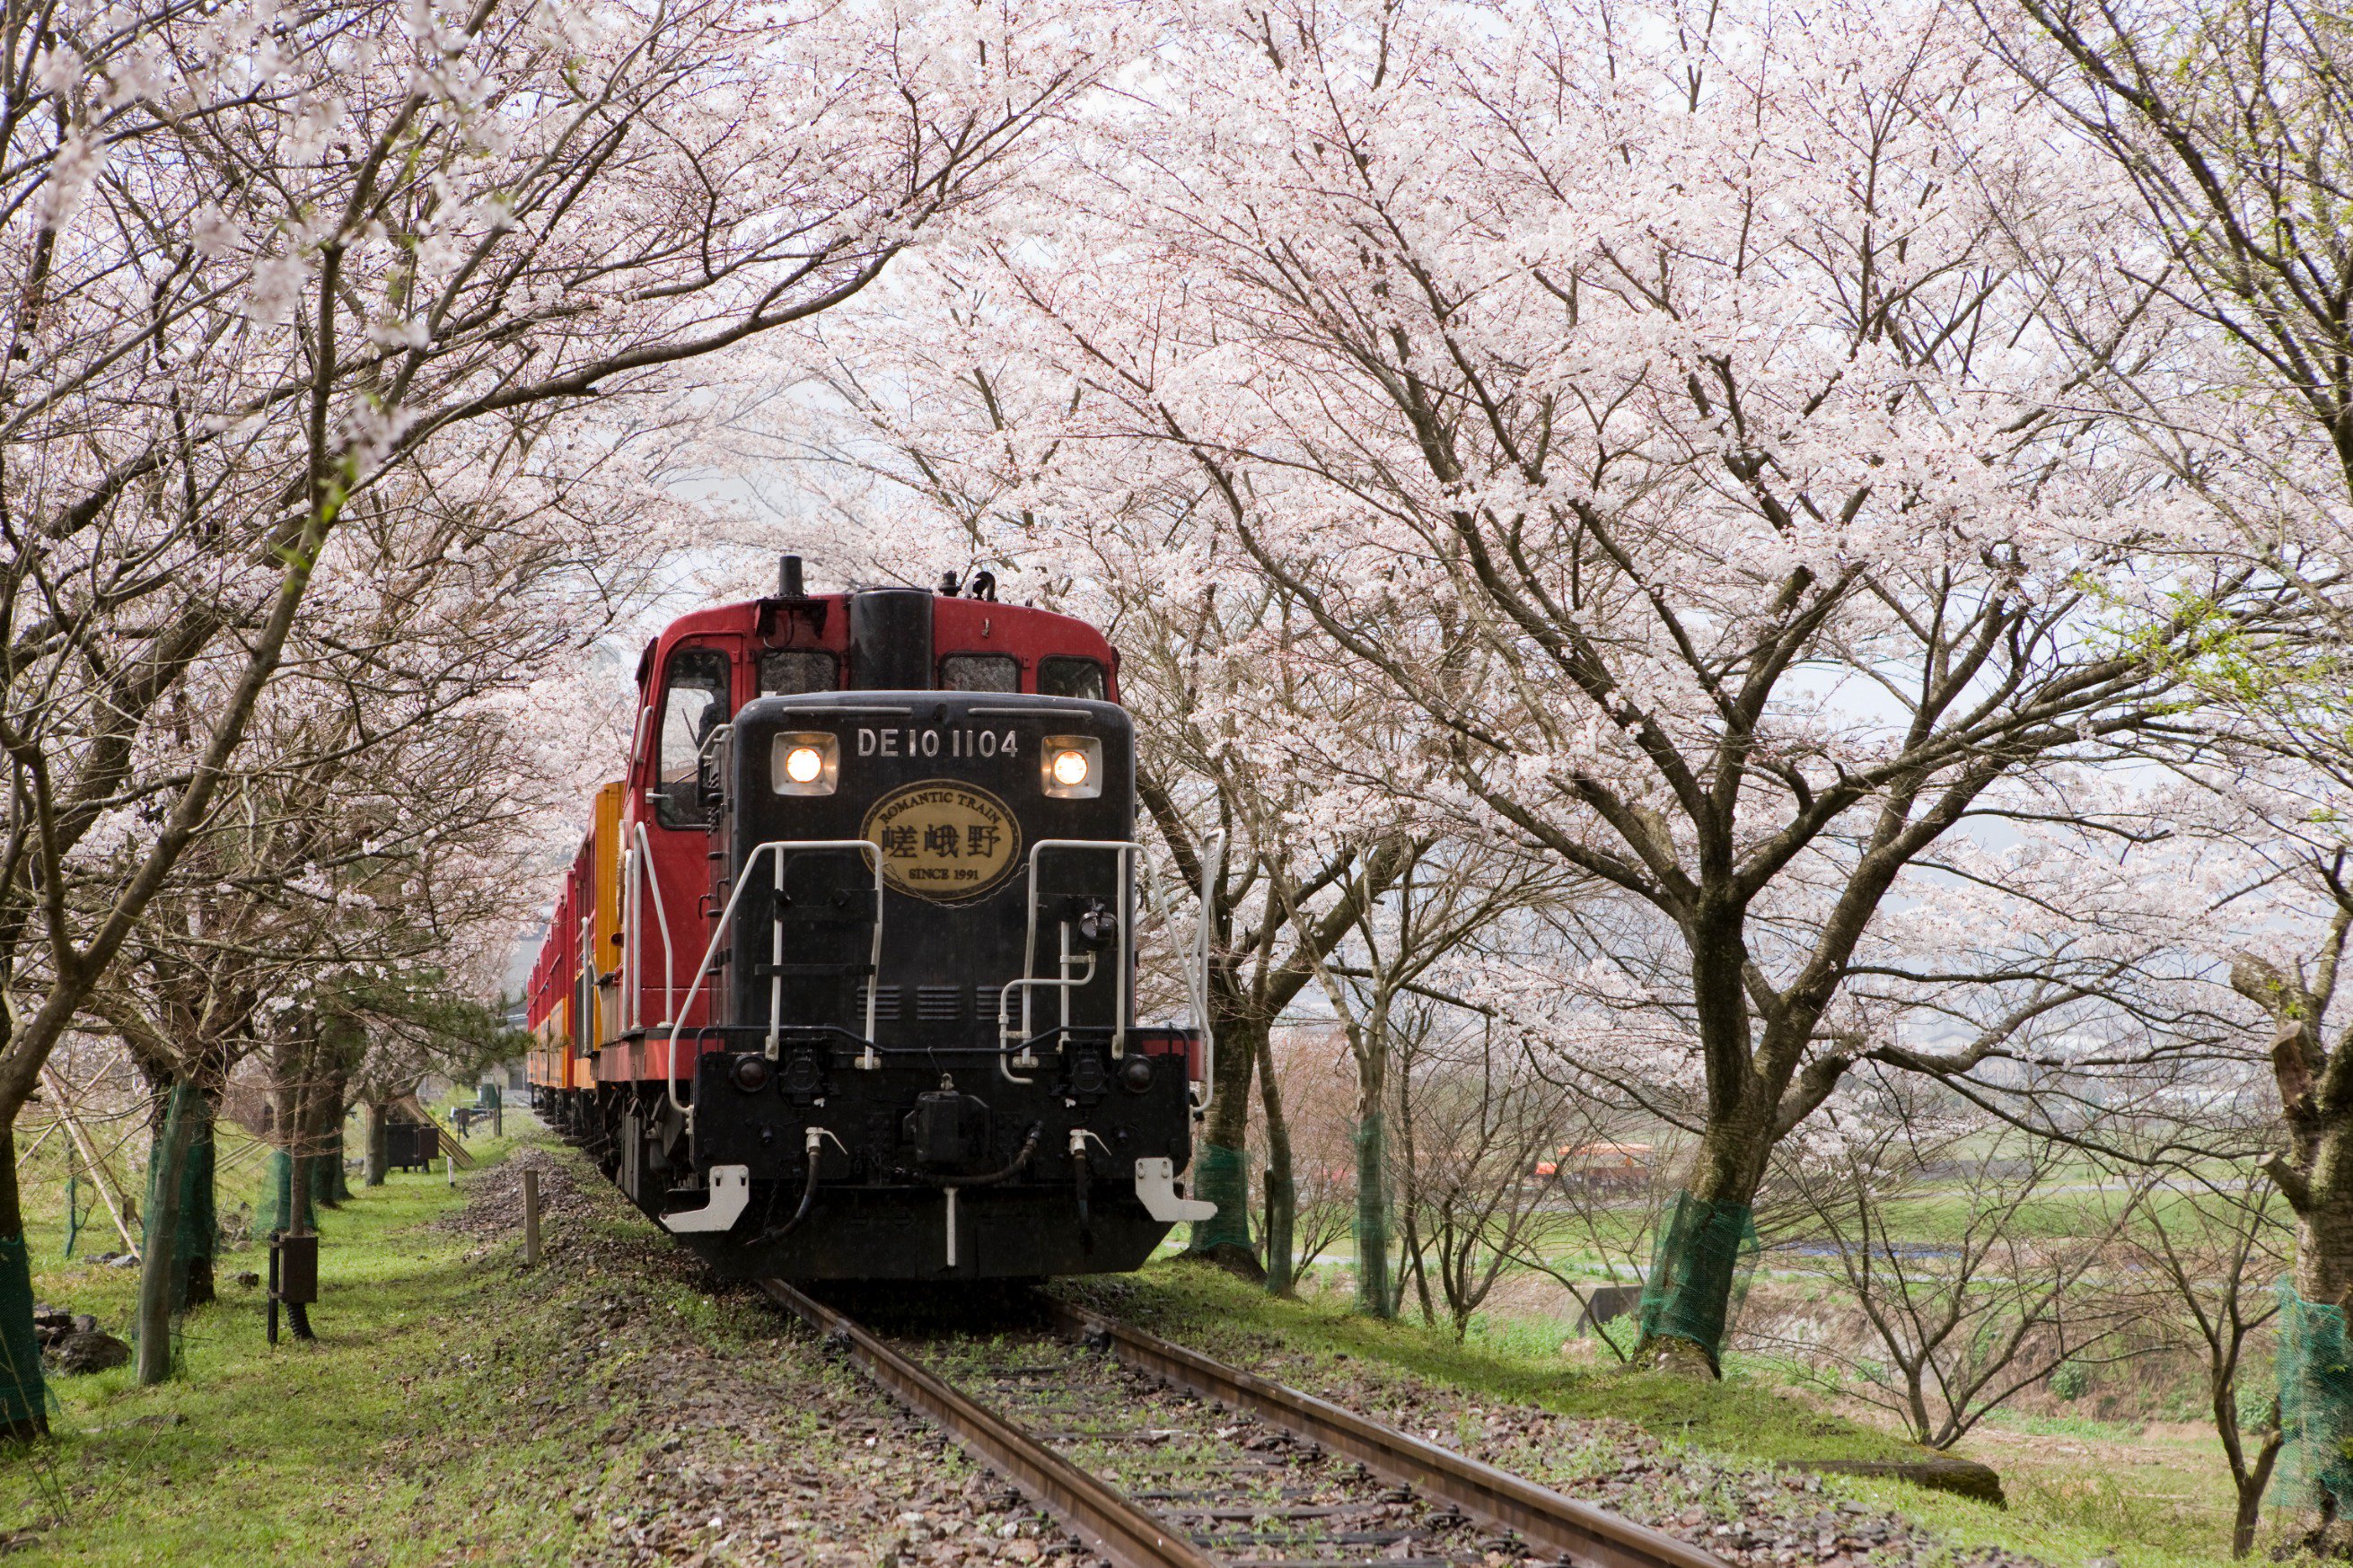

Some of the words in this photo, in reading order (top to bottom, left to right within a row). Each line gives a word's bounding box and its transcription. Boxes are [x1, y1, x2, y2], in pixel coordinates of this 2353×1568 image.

[858, 728, 899, 758] DE
[909, 729, 940, 758] 10
[953, 730, 1018, 758] 1104
[879, 792, 953, 824] ROMANTIC
[958, 793, 1001, 824] TRAIN
[882, 824, 1001, 858] 嵯峨野
[909, 868, 949, 880] SINCE
[953, 869, 979, 880] 1991
